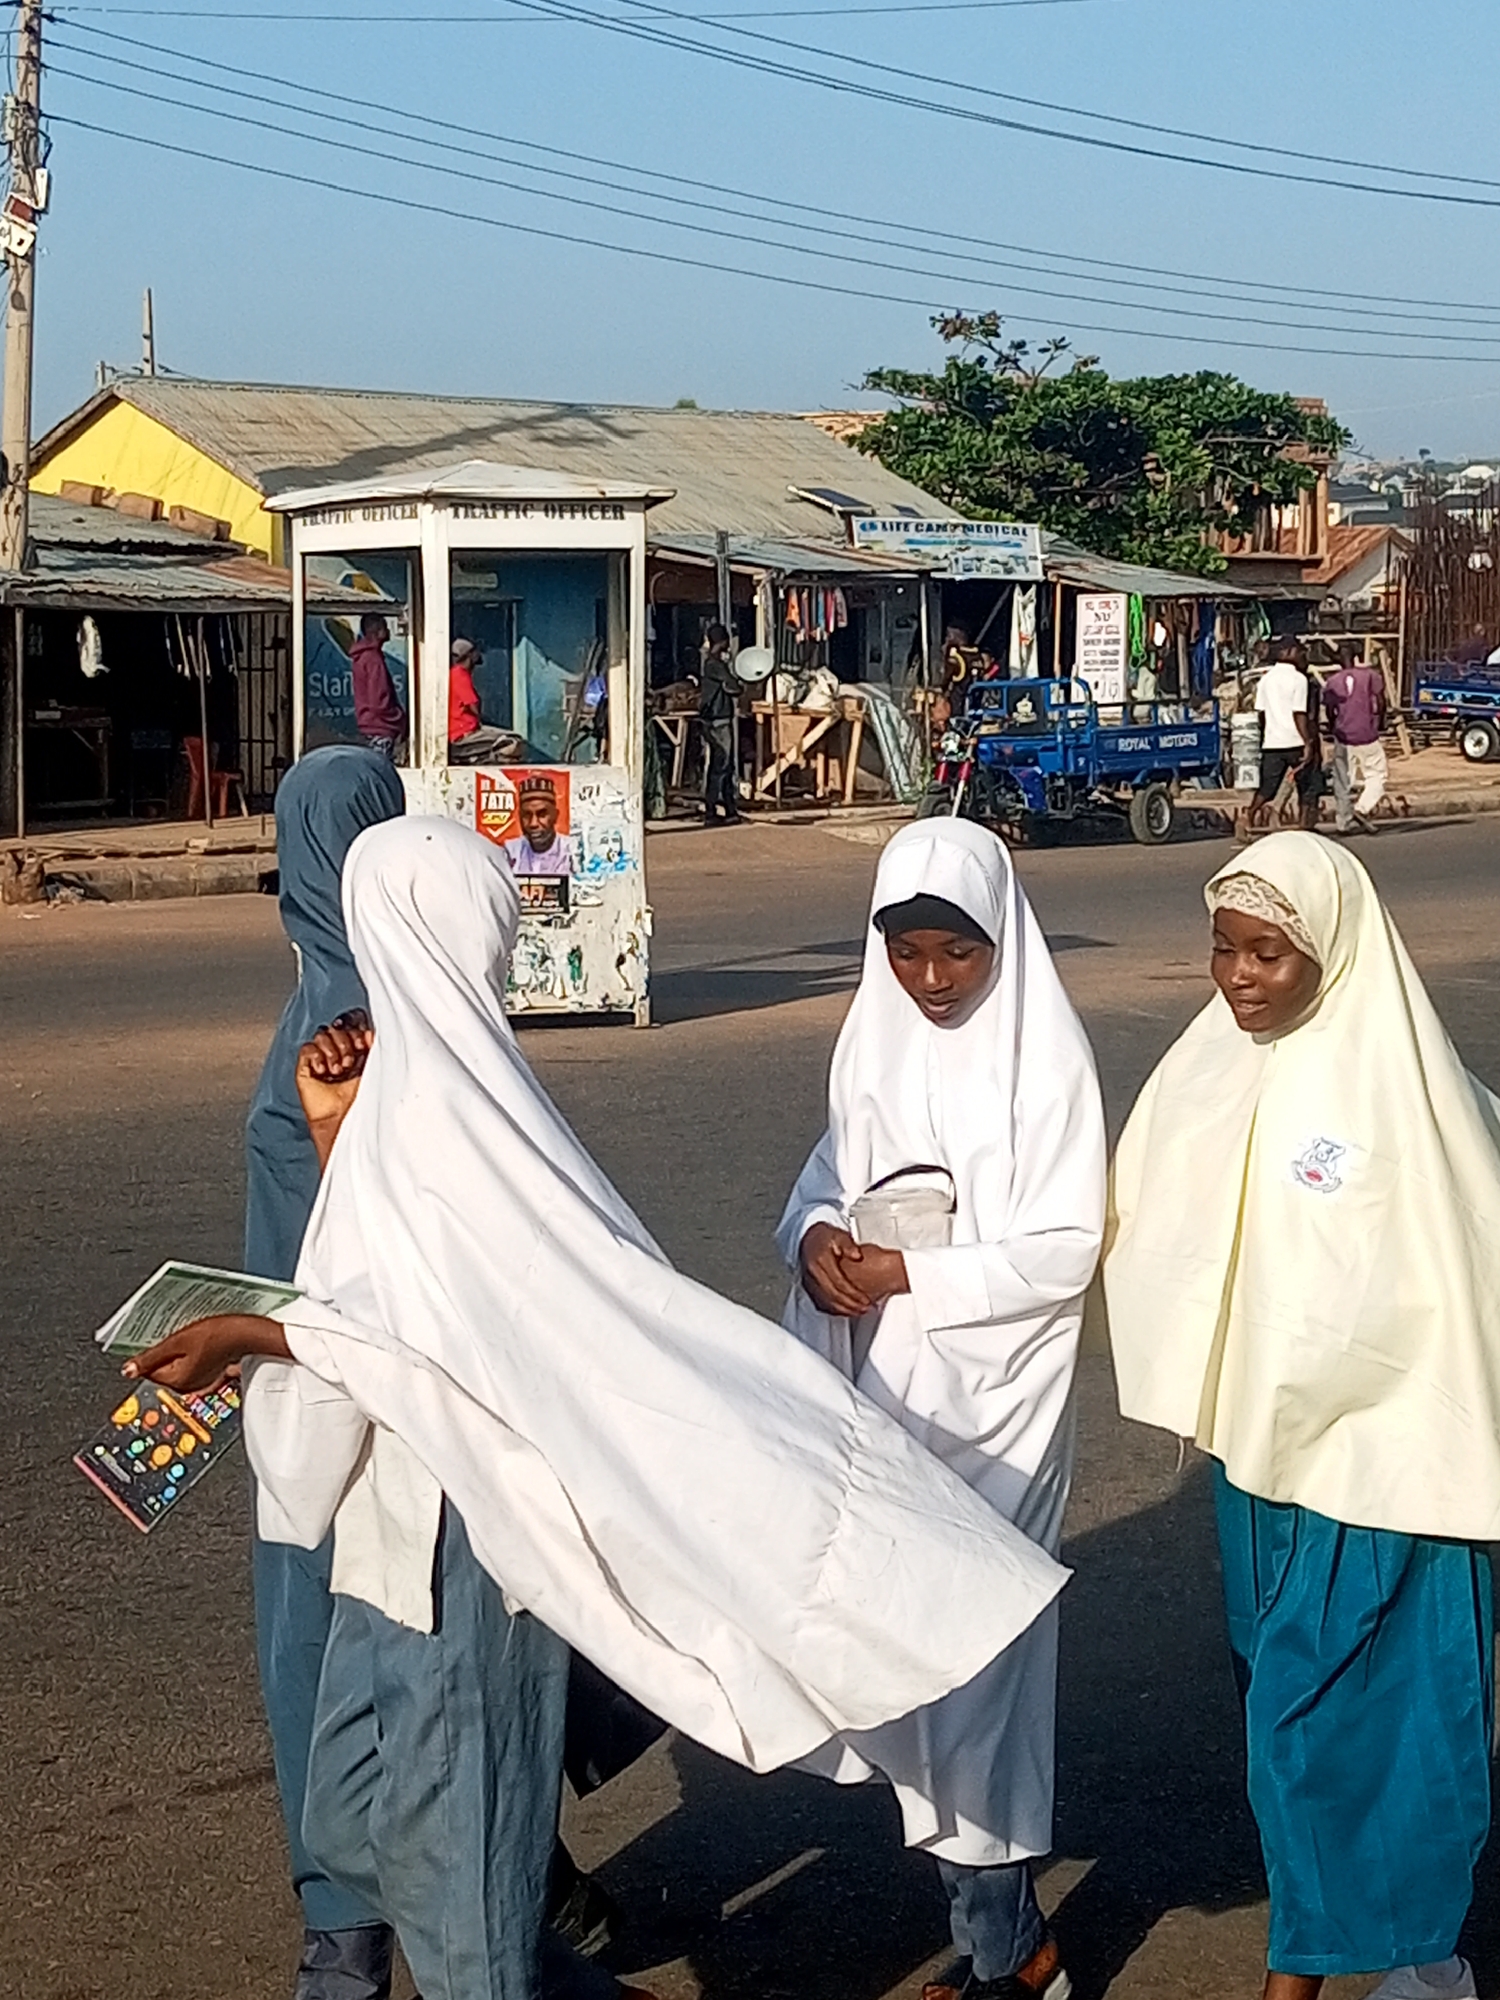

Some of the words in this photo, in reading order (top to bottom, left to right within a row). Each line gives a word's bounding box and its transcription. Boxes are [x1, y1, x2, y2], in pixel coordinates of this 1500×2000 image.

[363, 504, 419, 521] OFFICER
[452, 503, 535, 519] TRAFFIC
[544, 503, 626, 520] OFFICER
[881, 521, 911, 533] LIFE
[1118, 736, 1151, 752] ROYAL
[1158, 733, 1198, 749] MOTORS
